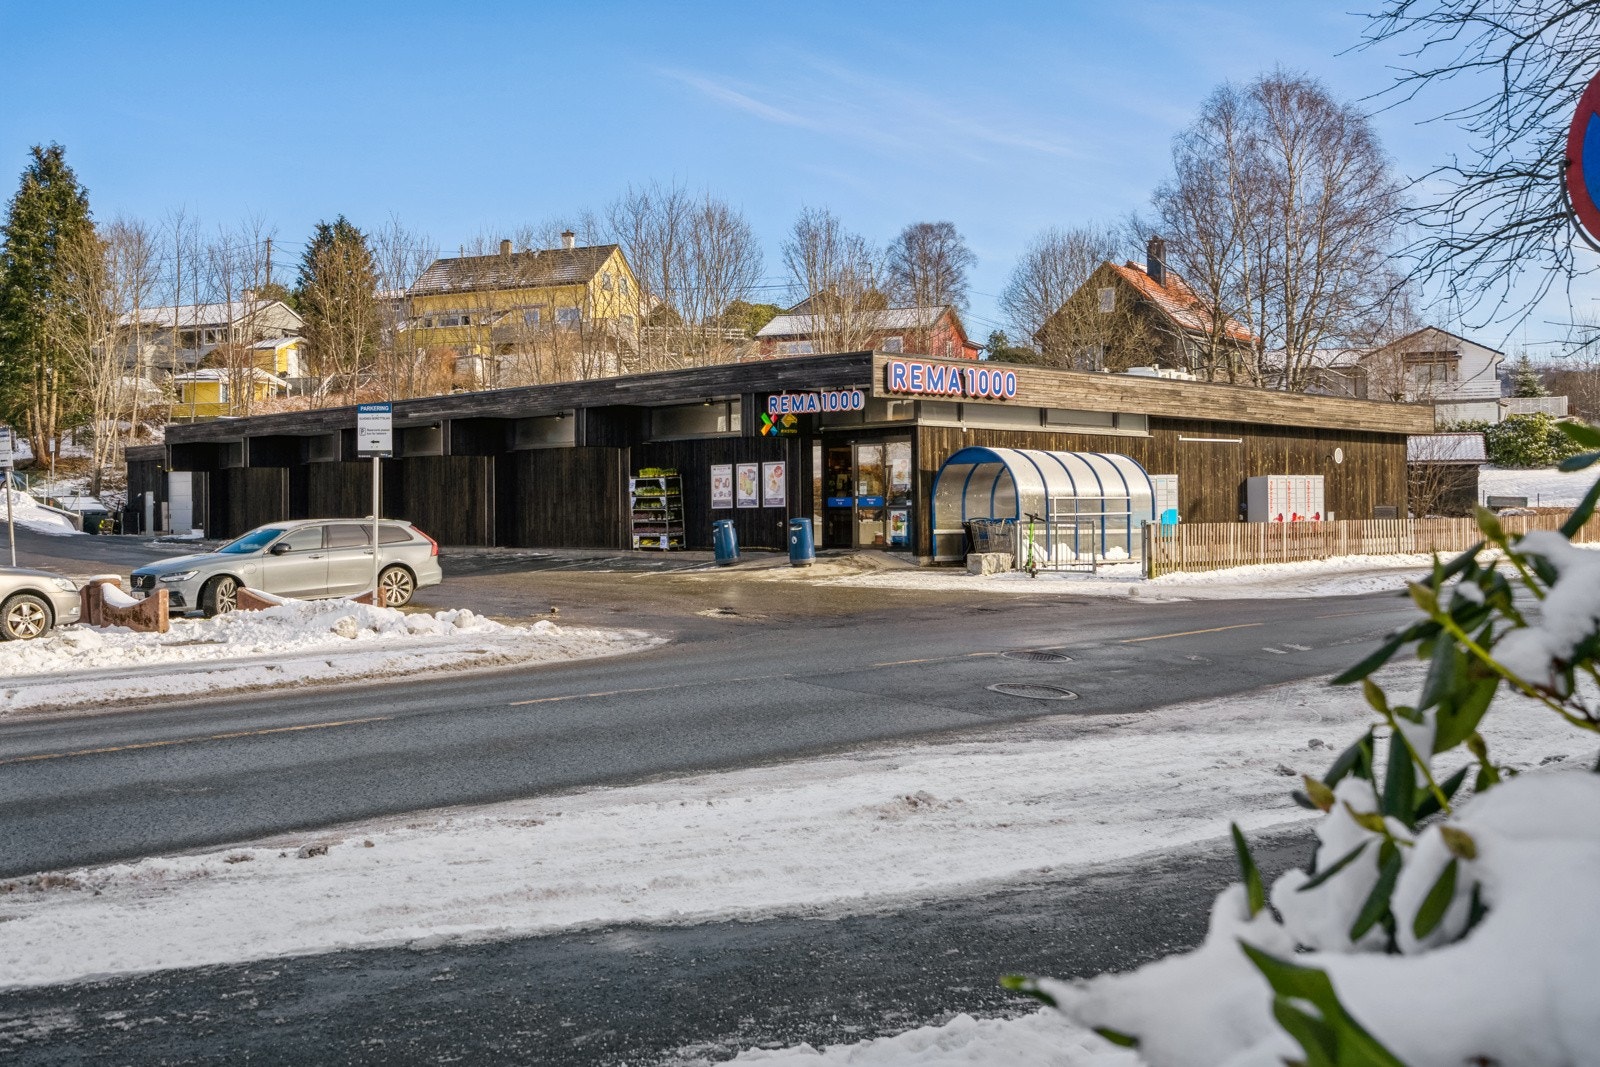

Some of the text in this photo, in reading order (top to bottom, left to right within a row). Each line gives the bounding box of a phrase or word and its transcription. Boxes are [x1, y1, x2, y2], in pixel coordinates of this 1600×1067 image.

[890, 362, 1017, 398] REMA 1000
[768, 390, 865, 414] REMA 1000
